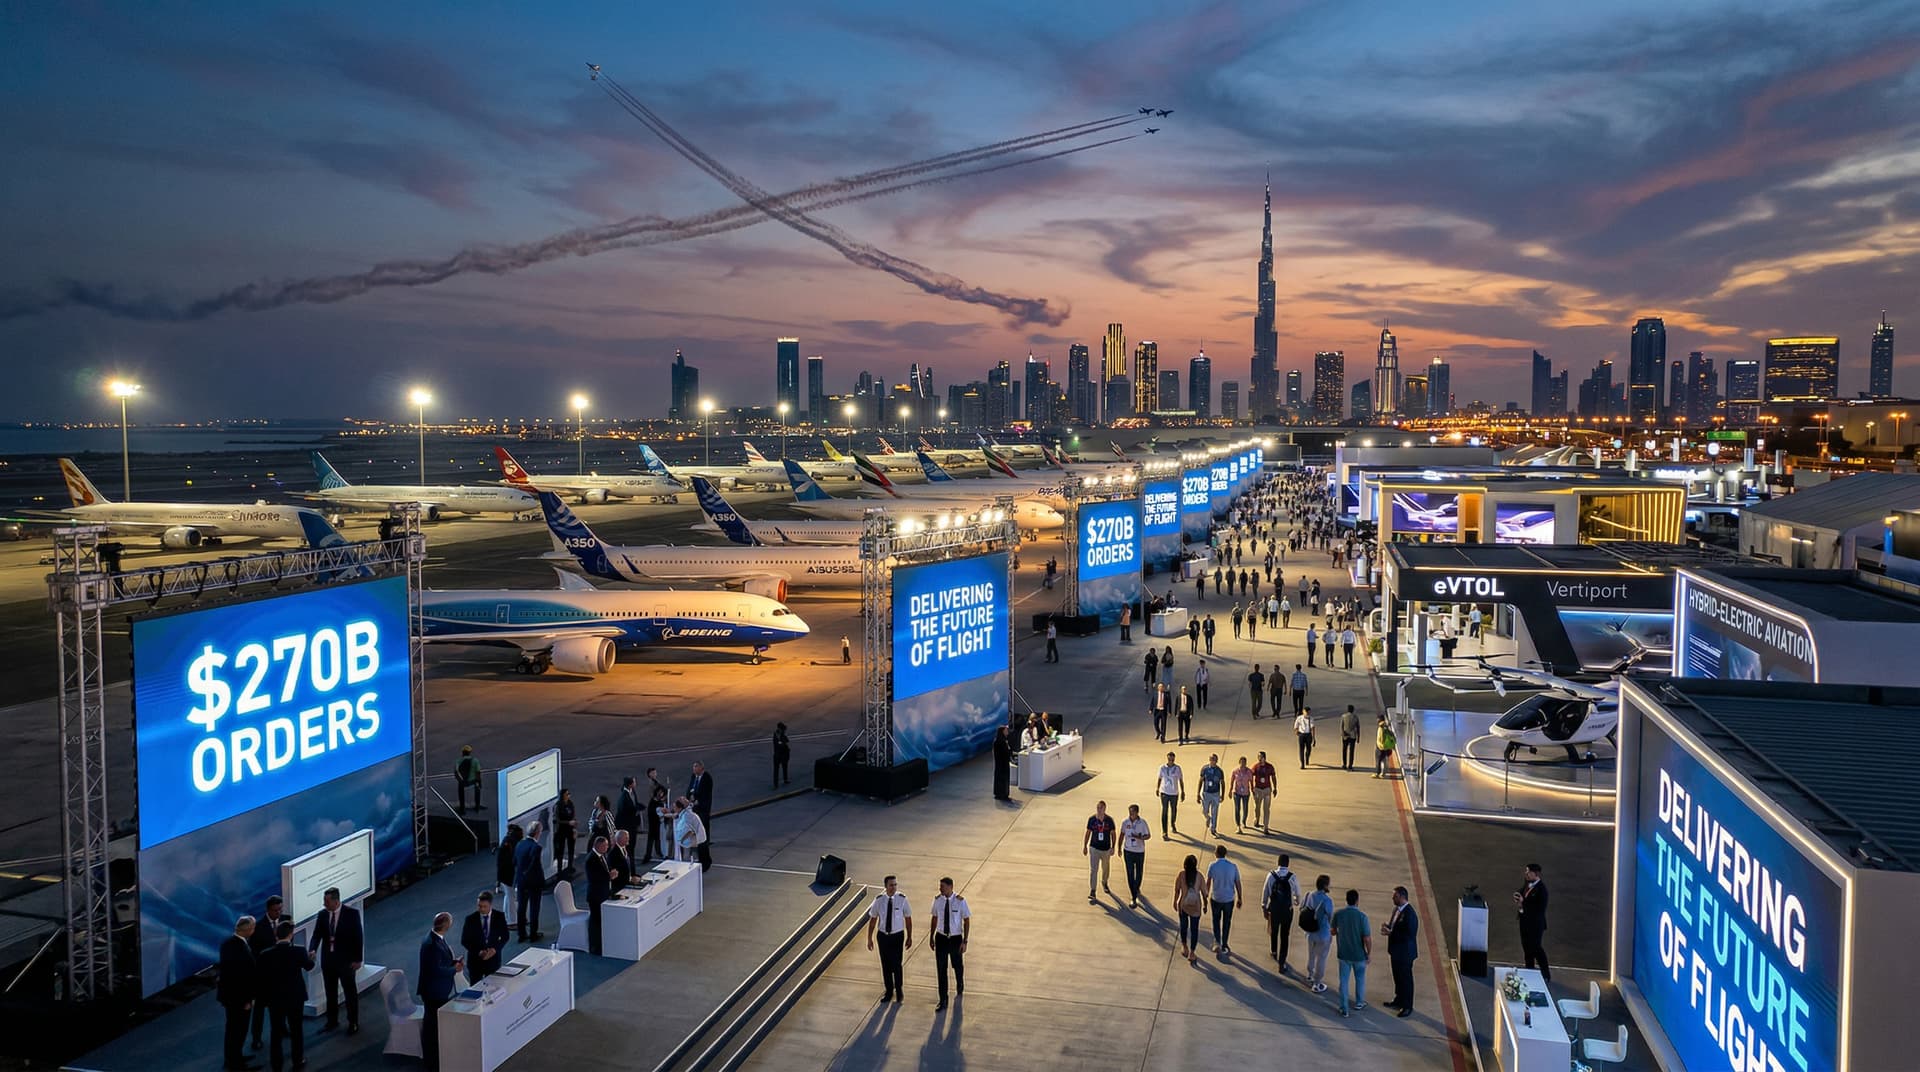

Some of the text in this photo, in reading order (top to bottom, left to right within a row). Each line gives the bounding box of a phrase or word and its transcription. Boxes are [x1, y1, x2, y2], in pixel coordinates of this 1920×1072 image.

[1182, 476, 1209, 494] $270B
[711, 512, 736, 522] A350
[1087, 515, 1134, 547] $270B
[1144, 514, 1154, 526] OF
[564, 537, 596, 548] A350
[1087, 542, 1134, 567] ORDERS
[911, 582, 994, 617] DELIVERING
[1434, 576, 1628, 602] eVTOL Vertiport
[680, 629, 733, 637] BOEING
[911, 604, 994, 640] THE FUTURE
[1689, 588, 1763, 639] HYBRID-ELECTRIC
[1764, 622, 1814, 665] AVIATION
[911, 625, 993, 667] OF FLIGHT
[186, 620, 380, 732] $270B
[192, 692, 380, 792] ORDERS
[1658, 768, 1807, 973] DELIVERING
[1655, 831, 1810, 1072] THE FUTURE
[1658, 910, 1688, 984] OF
